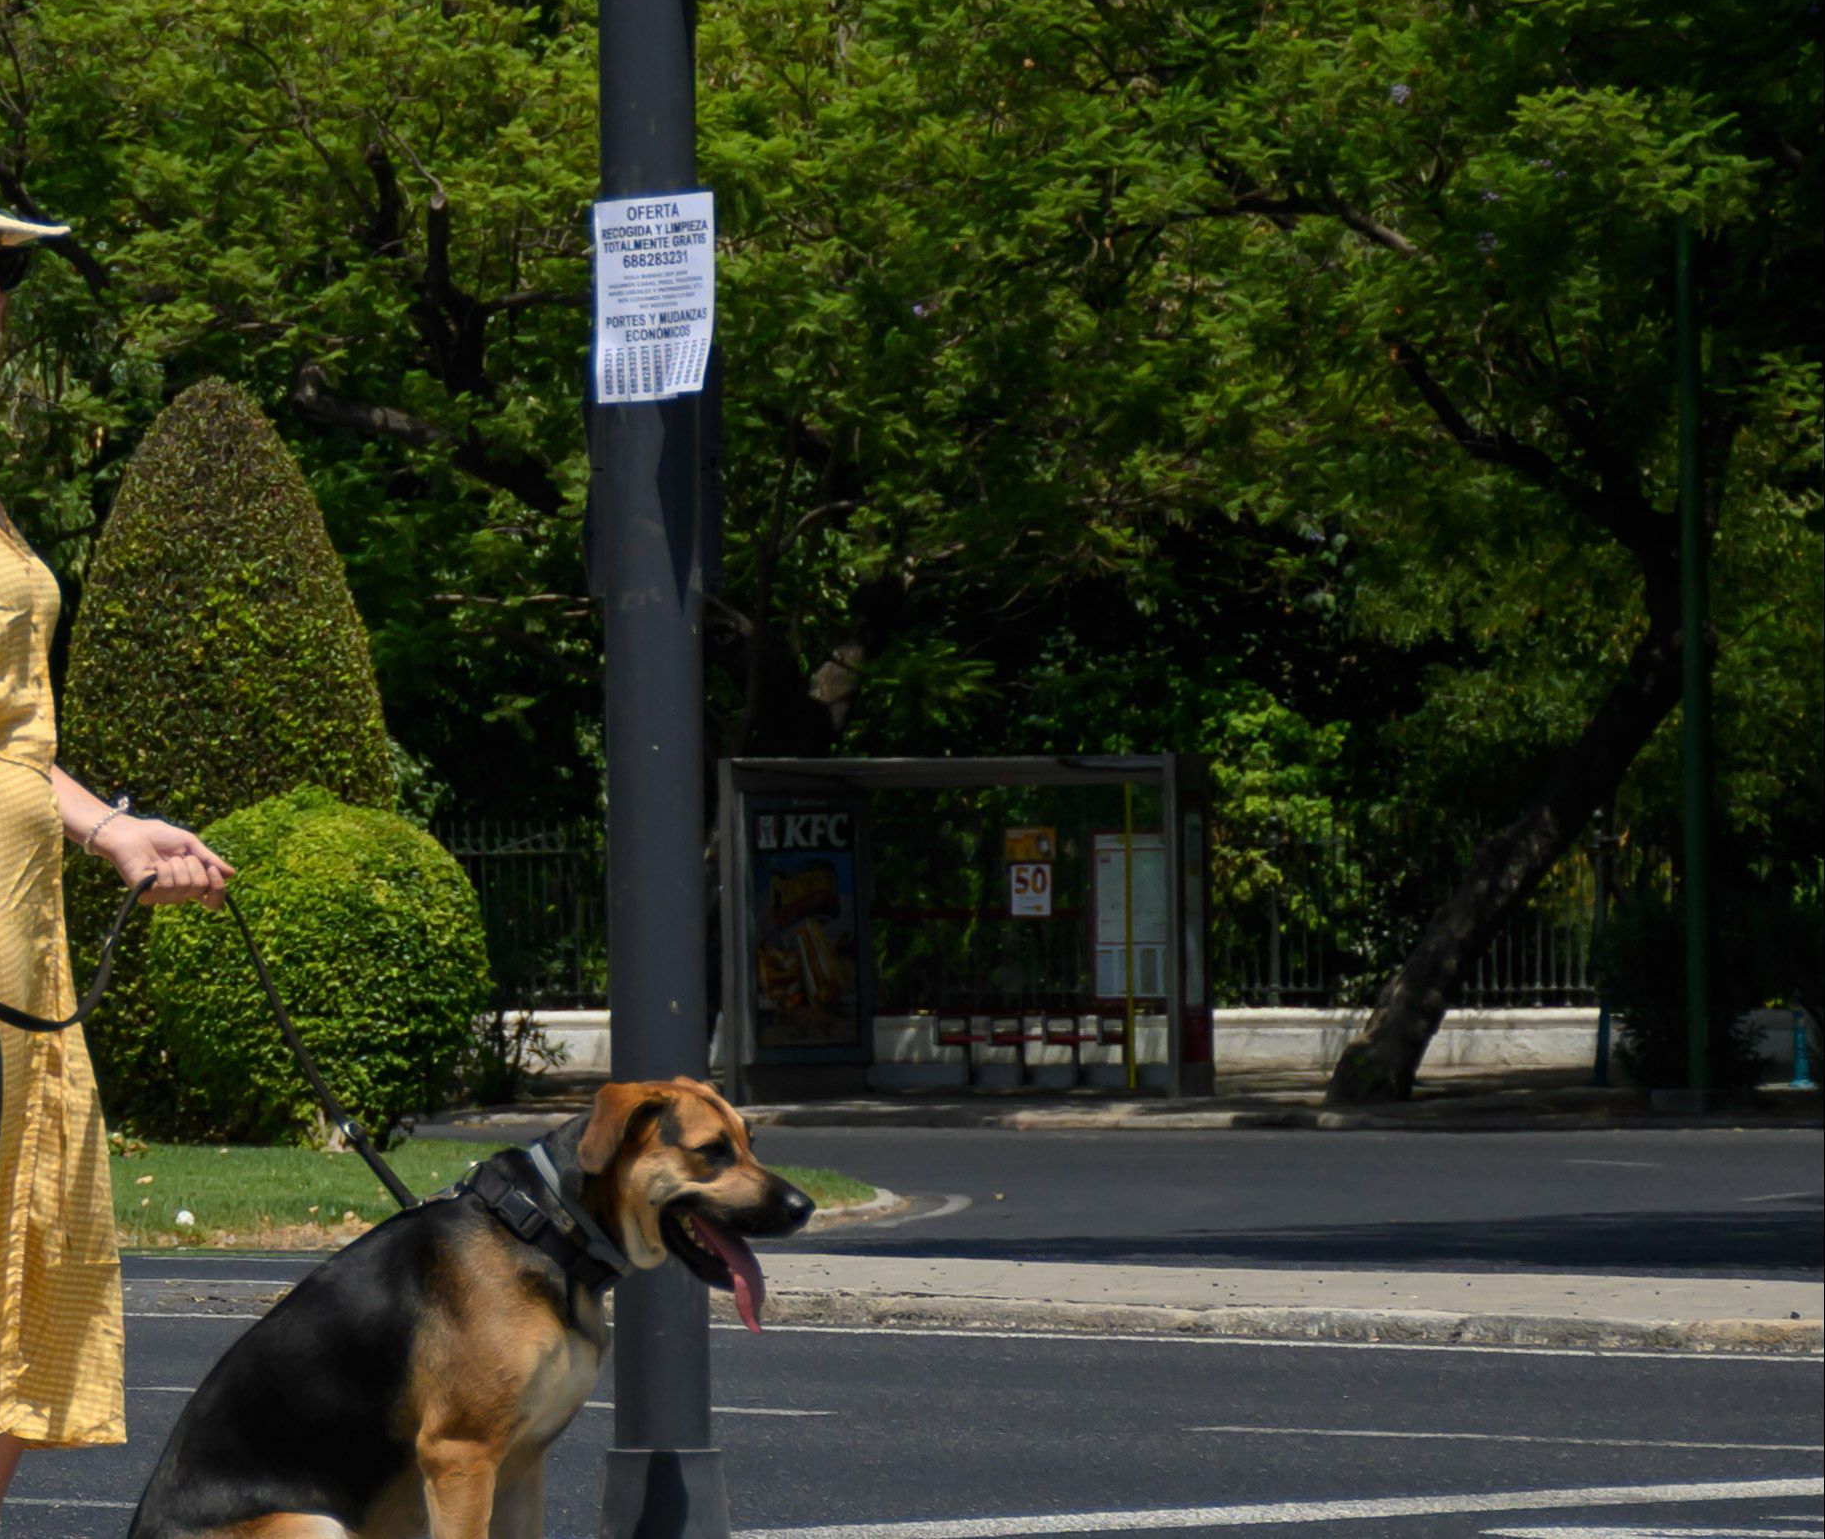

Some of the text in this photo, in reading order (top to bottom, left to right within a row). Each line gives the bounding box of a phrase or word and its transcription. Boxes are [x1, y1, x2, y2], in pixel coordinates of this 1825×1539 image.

[627, 202, 680, 221] OFERTA
[602, 219, 708, 240] RECOGIDA Y LIMPIEZA
[604, 233, 706, 253] TOTALMENTE GRATIS
[623, 250, 688, 269] 688283231
[606, 307, 707, 329] PORTES Y MUDANZAS
[782, 812, 849, 848] KFC
[1014, 866, 1047, 895] 50
